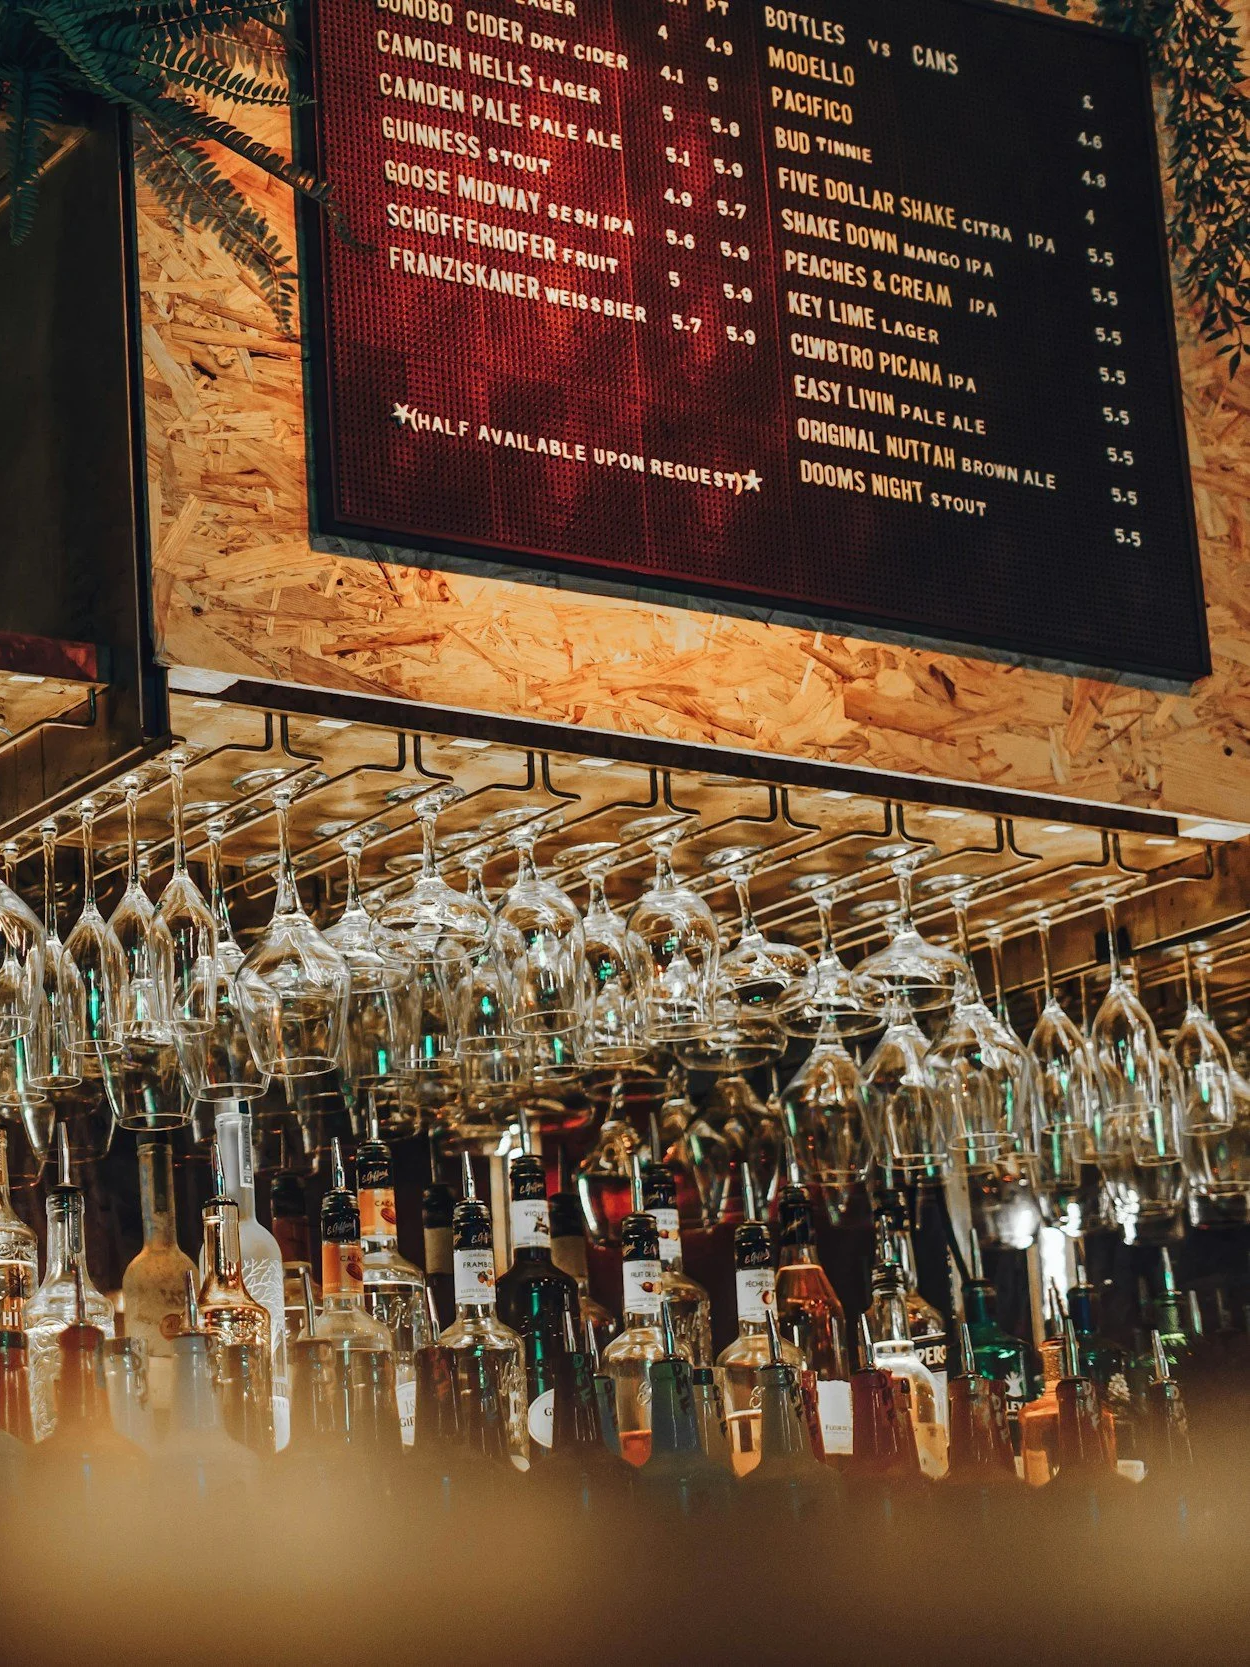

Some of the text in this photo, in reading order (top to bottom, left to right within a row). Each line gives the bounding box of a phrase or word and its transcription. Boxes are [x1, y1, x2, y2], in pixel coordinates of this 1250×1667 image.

[466, 10, 523, 44] CIDER
[531, 32, 566, 54] DRY
[574, 44, 628, 70] CIDER
[661, 66, 683, 84] 4.1
[708, 77, 718, 91] 5
[514, 0, 732, 55] AGER 4 4.9
[706, 0, 728, 15] PT
[765, 6, 845, 45] BOTTLES
[913, 45, 958, 74] CANS
[378, 30, 739, 137] CAMDEN HELLS LAGER 5 5.8
[380, 73, 743, 178] CAMDEN PALE PALE ALE 5.1 5.9
[769, 47, 1102, 149] MODELLO 4.6
[383, 116, 746, 219] GUINNESS STOUT 4.9 5.7
[772, 86, 1106, 188] PACIFICO 4.8
[775, 127, 1094, 224] BUD TINNIE 4
[385, 160, 749, 261] GOOSE MIDWAY SESH IPA 5.6 5.9
[386, 203, 752, 303] SCHÖFFERHOFER FRUIT 5 5.9
[779, 167, 1114, 266] FIVE DOLLAR SHAKE CITRA IPA 5.5
[782, 209, 1118, 305] SHAKE DOWN MANGO IPA 5.5
[389, 246, 755, 345] FRANZISKANER WEISSBIER 5.7 5.9
[785, 250, 1121, 345] PEACHES & CREAM IPA 5.5
[788, 291, 1125, 385] KEY LIME LAGER 5.5
[794, 375, 1133, 465] EASY LIVIN PALE ALE 5.5
[879, 352, 942, 385] PICANA
[949, 374, 976, 393] IPA
[1103, 407, 1129, 425] 5.5
[478, 425, 586, 461] AVAILABLE
[594, 448, 644, 472] UPON
[798, 418, 1137, 505] ORIGINAL NUTTAH BROWN ALE 5.5
[800, 460, 1141, 547] DOOMS NIGHT STOUT 5.5
